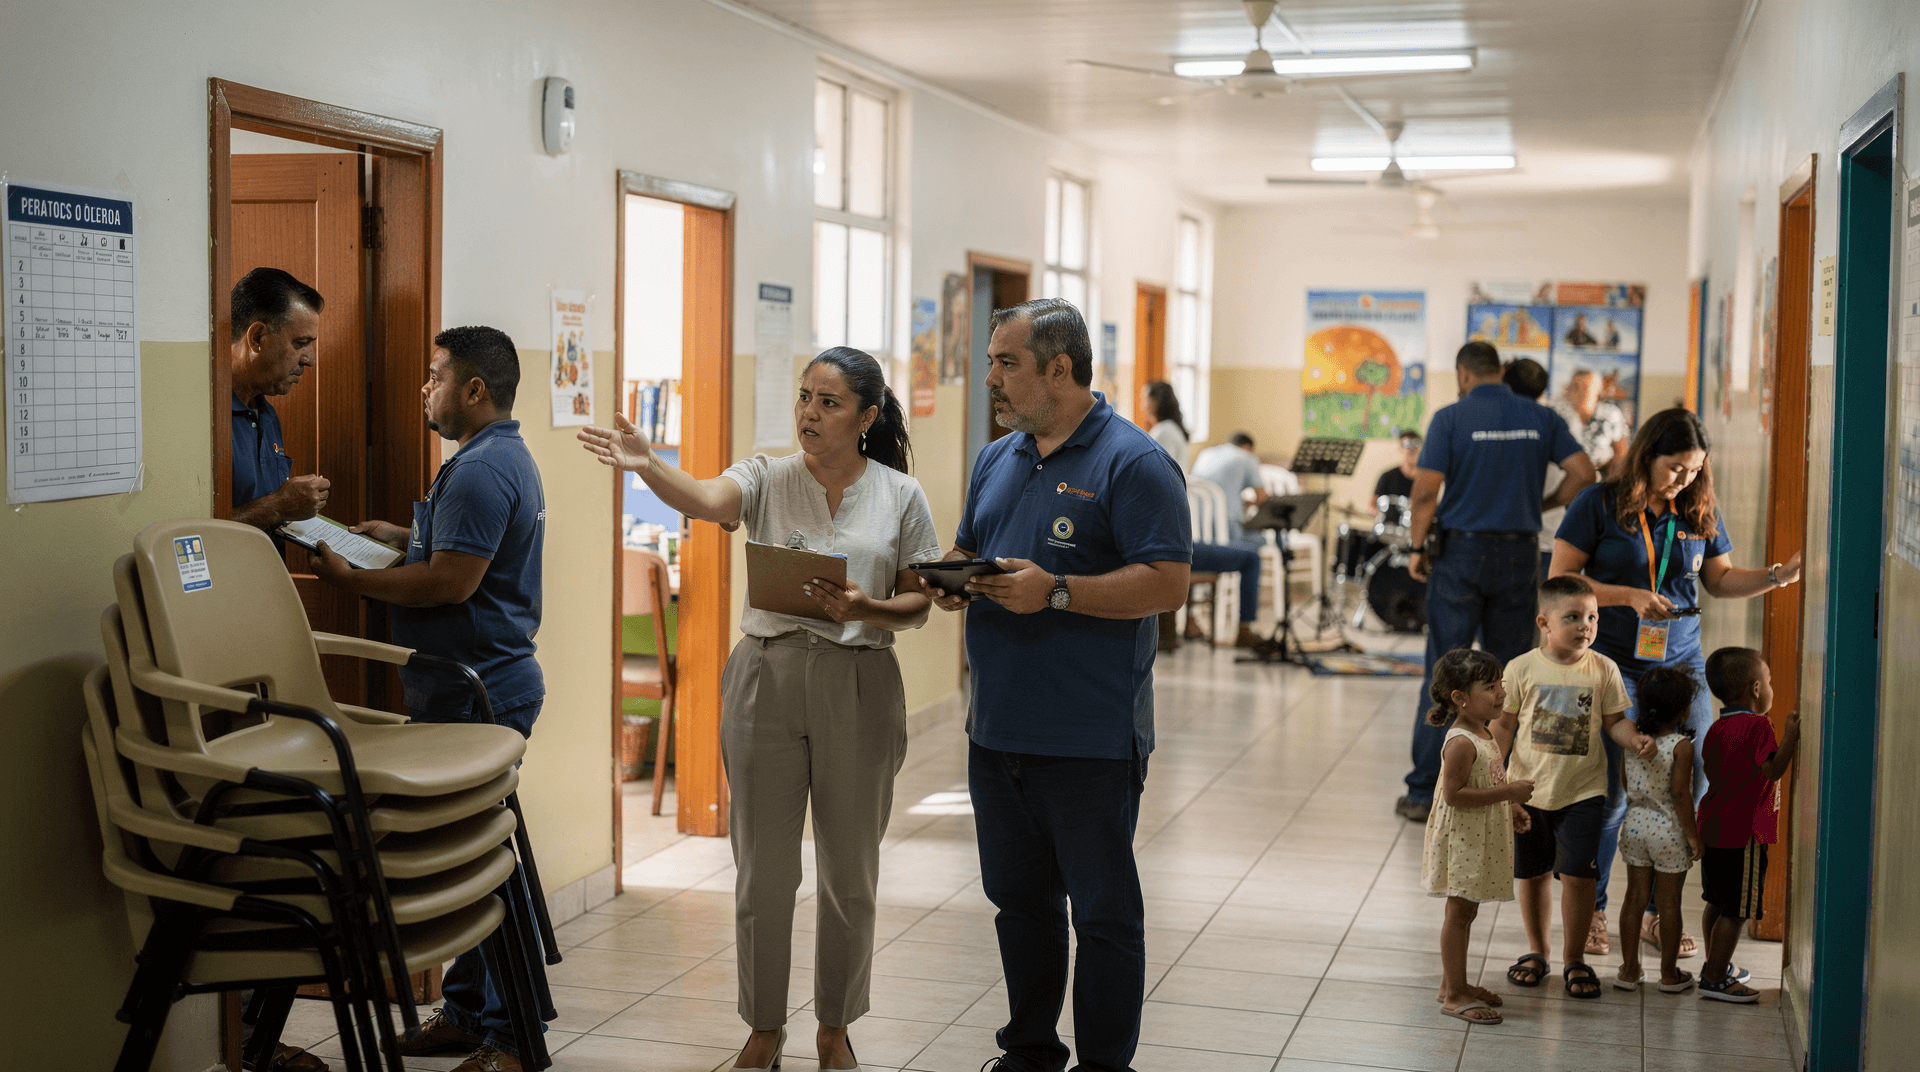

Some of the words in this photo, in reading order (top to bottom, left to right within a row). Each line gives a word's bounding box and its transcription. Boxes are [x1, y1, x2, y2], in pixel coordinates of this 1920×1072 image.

[21, 197, 72, 220] PERATOCS
[19, 260, 24, 272] 2
[19, 276, 24, 288] 3
[19, 294, 24, 305] 4
[20, 310, 25, 322] 5
[20, 327, 25, 338] 6
[20, 343, 26, 355] 8
[20, 359, 26, 371] 9
[19, 376, 28, 388] 10
[19, 392, 27, 404] 11
[19, 409, 29, 420] 12
